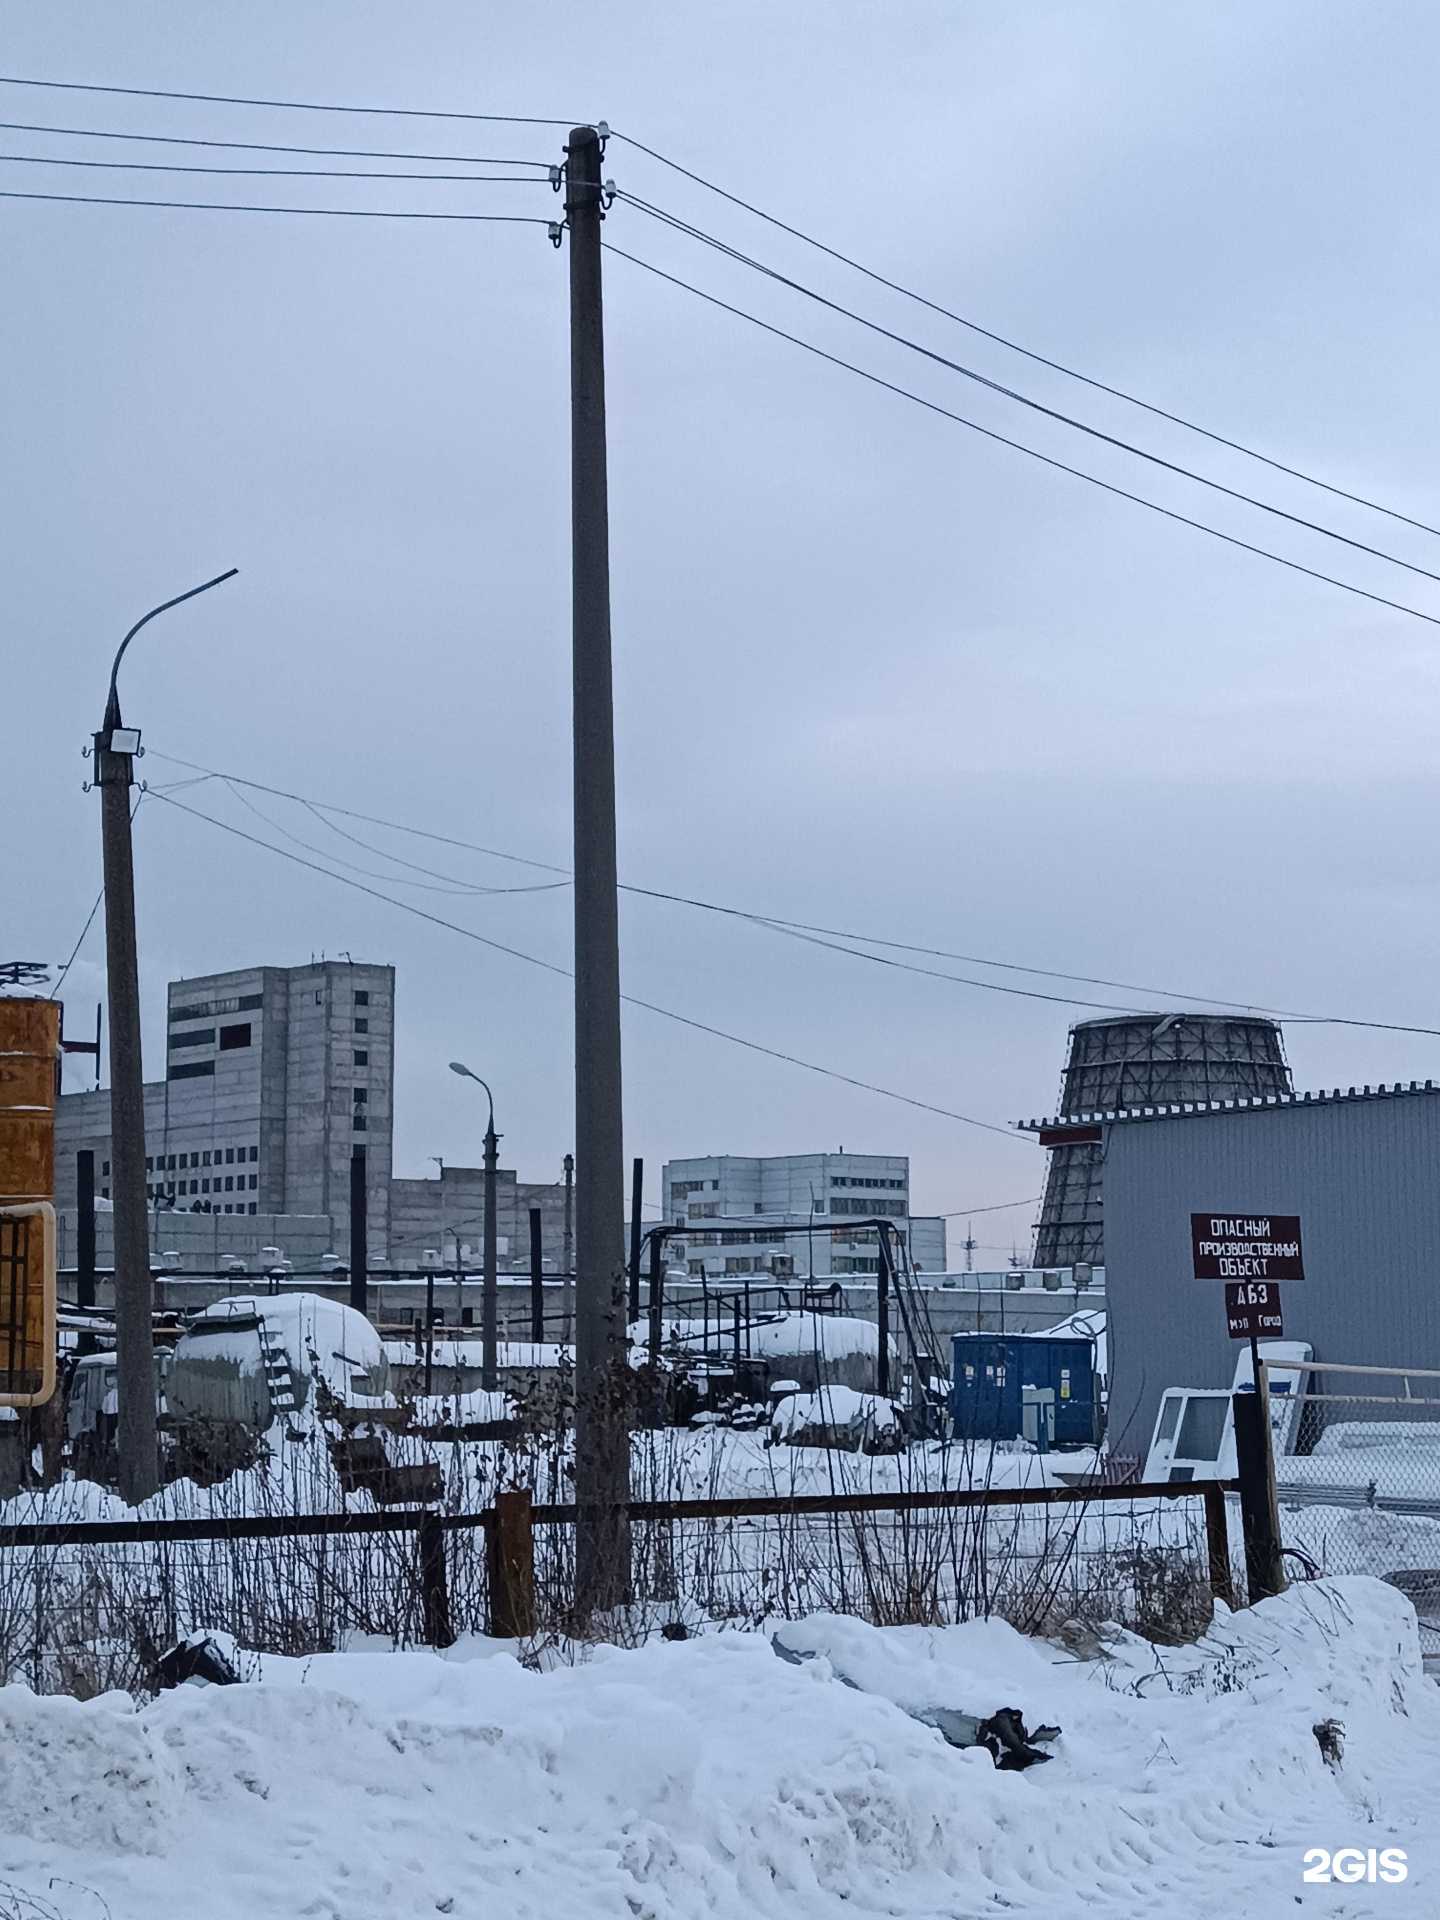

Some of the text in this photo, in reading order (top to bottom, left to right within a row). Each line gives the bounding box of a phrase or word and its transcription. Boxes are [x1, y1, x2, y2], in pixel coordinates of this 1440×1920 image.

[1210, 1217, 1271, 1237] ОПАСНЫЙ
[1199, 1241, 1299, 1257] ПРОИЗВОДСТВЕННЫЙ
[1219, 1258, 1268, 1276] ОБЪЕКТ
